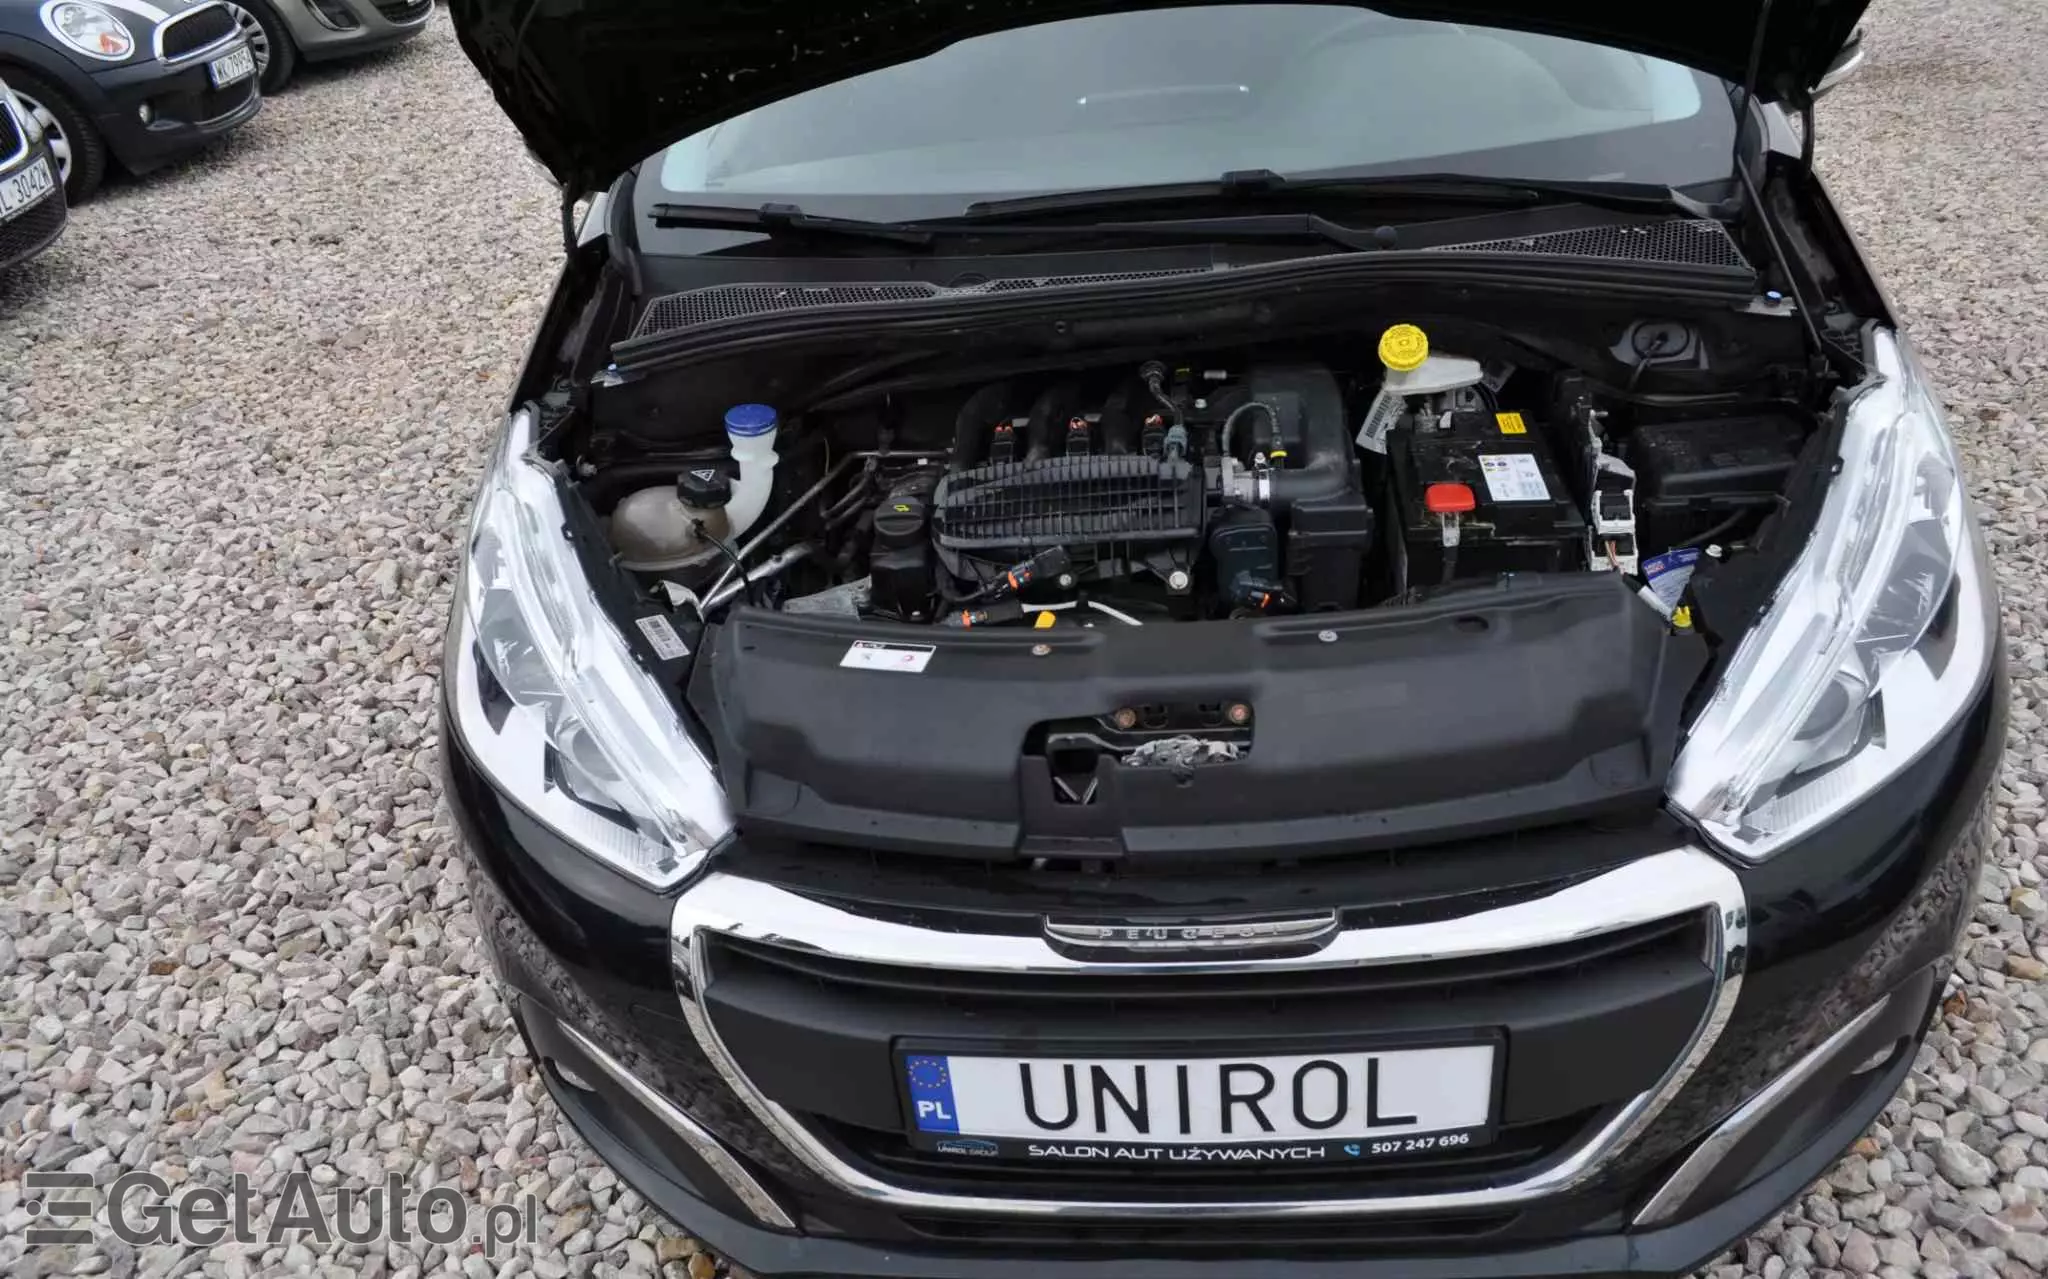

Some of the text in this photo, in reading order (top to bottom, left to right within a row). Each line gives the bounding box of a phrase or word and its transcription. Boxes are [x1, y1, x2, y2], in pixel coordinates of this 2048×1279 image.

[1019, 1057, 1418, 1134] UNIROL
[918, 1099, 952, 1120] PL
[1028, 1144, 1326, 1161] SALON AUT UŻYWANYCH
[1371, 1133, 1470, 1155] 507 247 696
